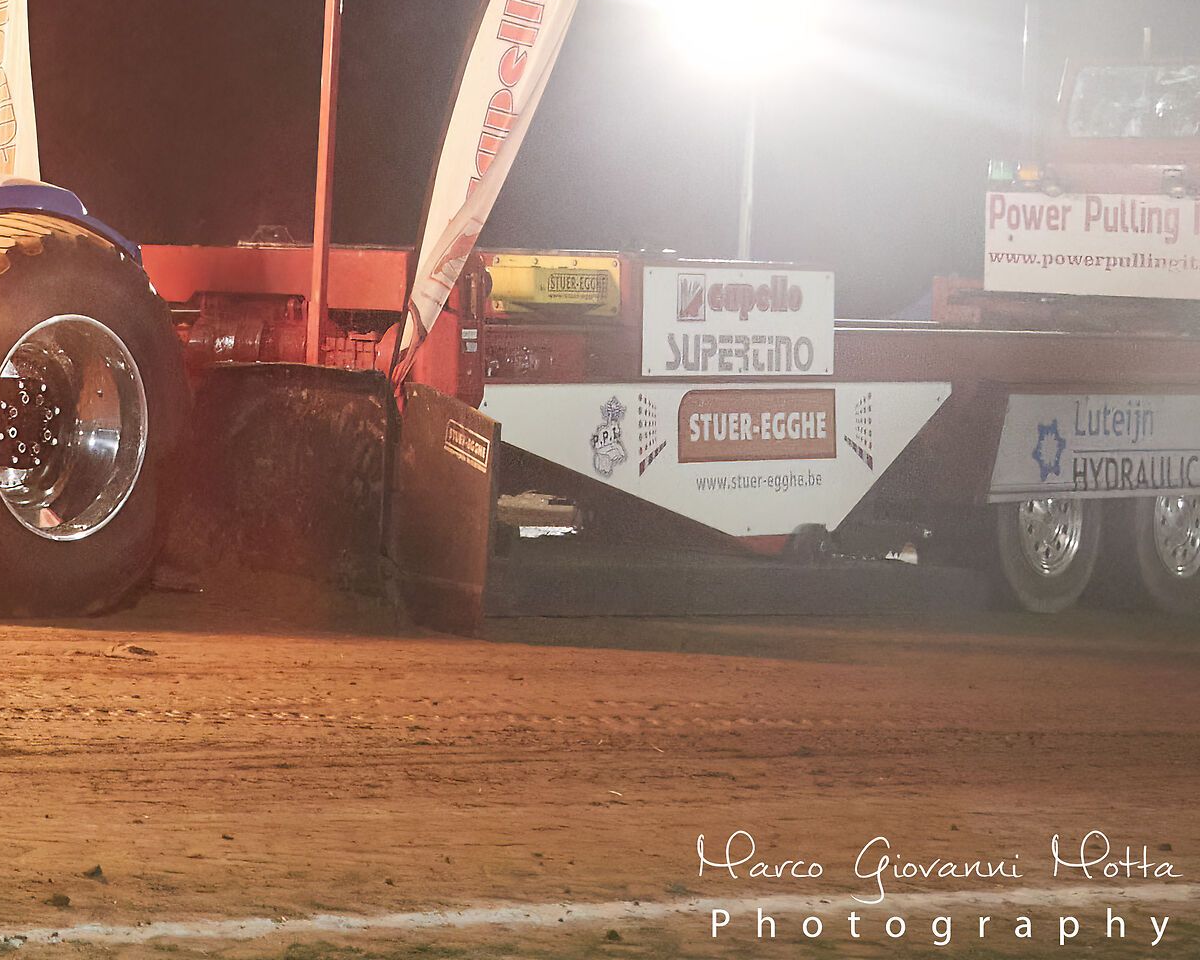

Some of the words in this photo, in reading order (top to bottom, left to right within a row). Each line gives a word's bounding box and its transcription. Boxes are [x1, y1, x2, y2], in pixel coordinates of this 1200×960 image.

[989, 194, 1073, 232] Power
[1084, 195, 1181, 245] Pulling
[988, 251, 1200, 273] www.powerpullingit
[707, 274, 803, 321] capello
[689, 411, 827, 442] STUER-EGGHE
[696, 469, 823, 493] www.stuer-egghe.be
